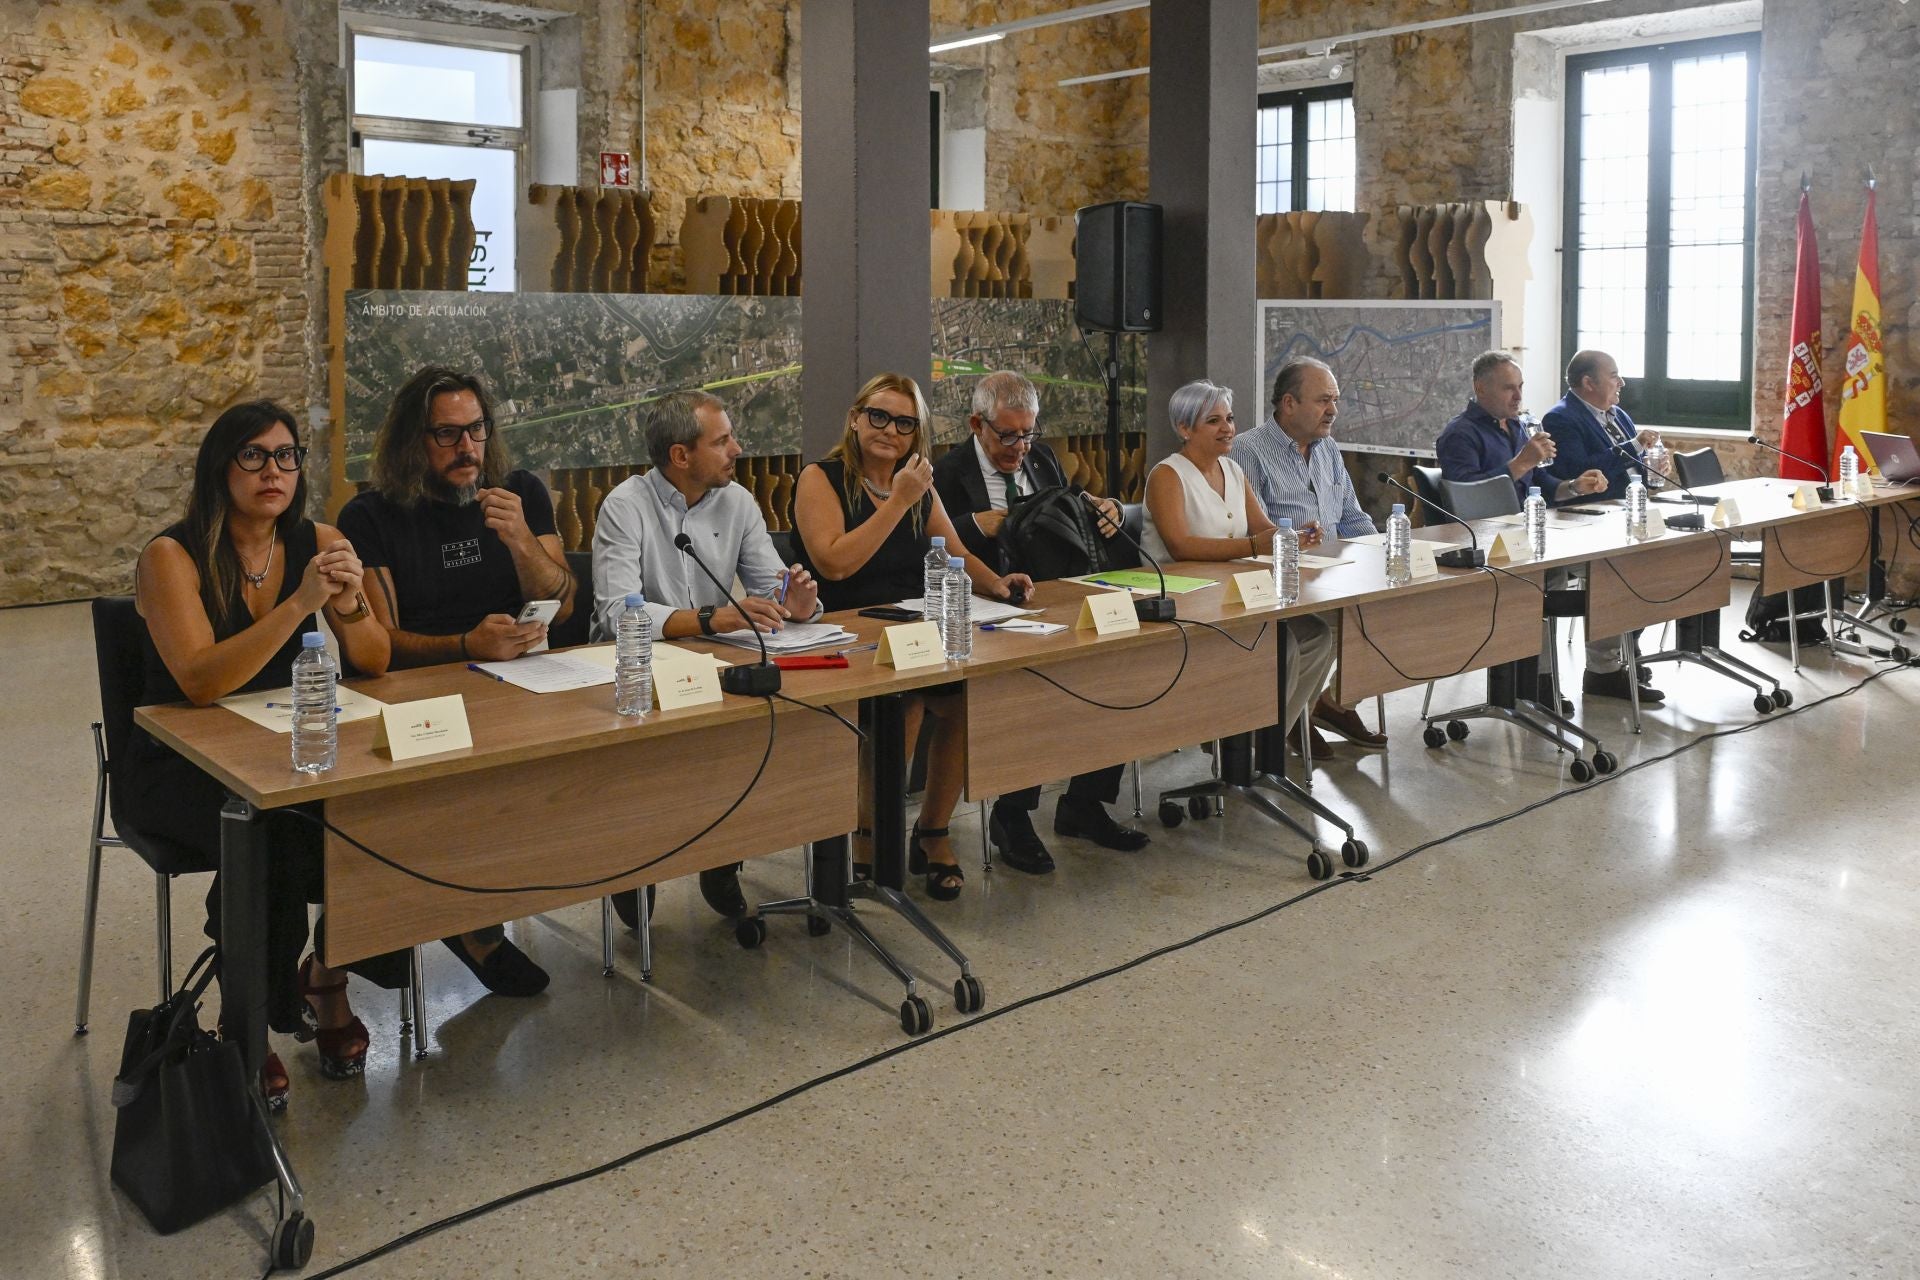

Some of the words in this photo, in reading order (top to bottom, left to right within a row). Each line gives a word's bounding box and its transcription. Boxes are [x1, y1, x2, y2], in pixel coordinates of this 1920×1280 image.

[362, 301, 404, 317] ÁMBITO
[408, 304, 423, 317] DE
[428, 302, 488, 317] ACTUACIÓN
